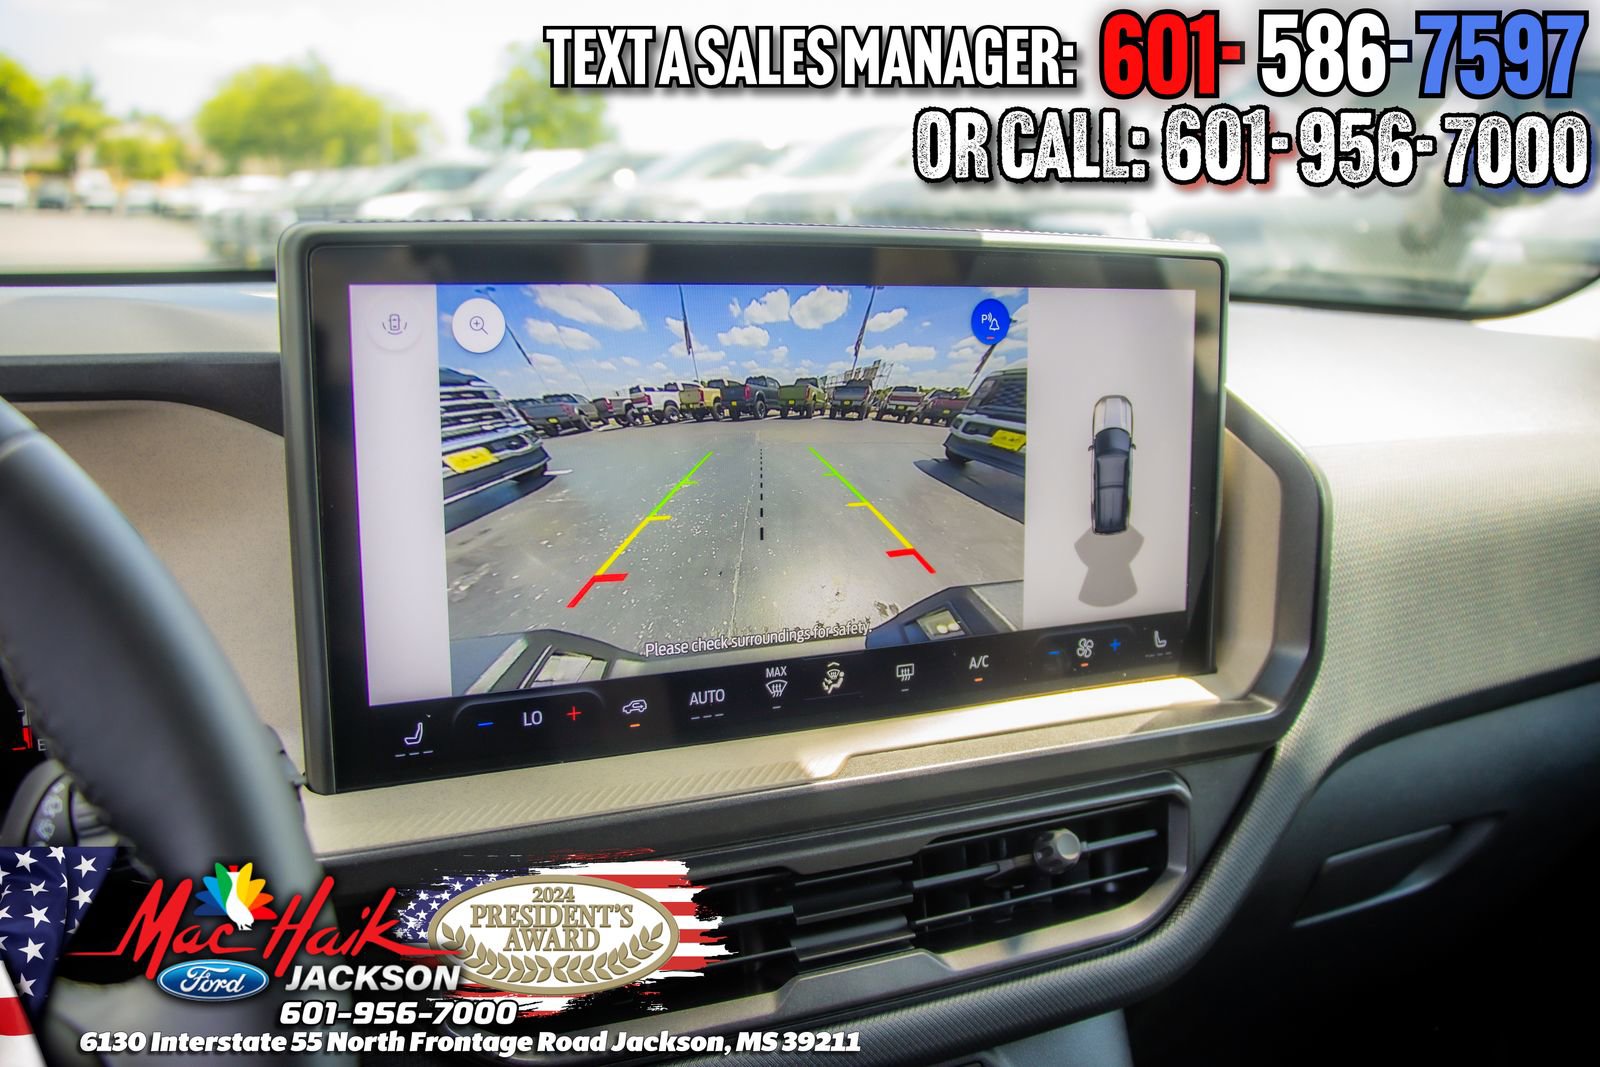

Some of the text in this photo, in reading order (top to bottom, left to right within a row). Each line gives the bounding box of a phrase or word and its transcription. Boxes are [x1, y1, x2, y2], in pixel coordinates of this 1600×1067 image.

[645, 640, 689, 657] Please
[691, 635, 730, 652] check
[731, 627, 811, 648] surroundings
[813, 623, 832, 639] for
[969, 655, 990, 670] A/C
[765, 666, 788, 678] MAX
[689, 689, 726, 706] AUTO
[523, 710, 543, 727] LO
